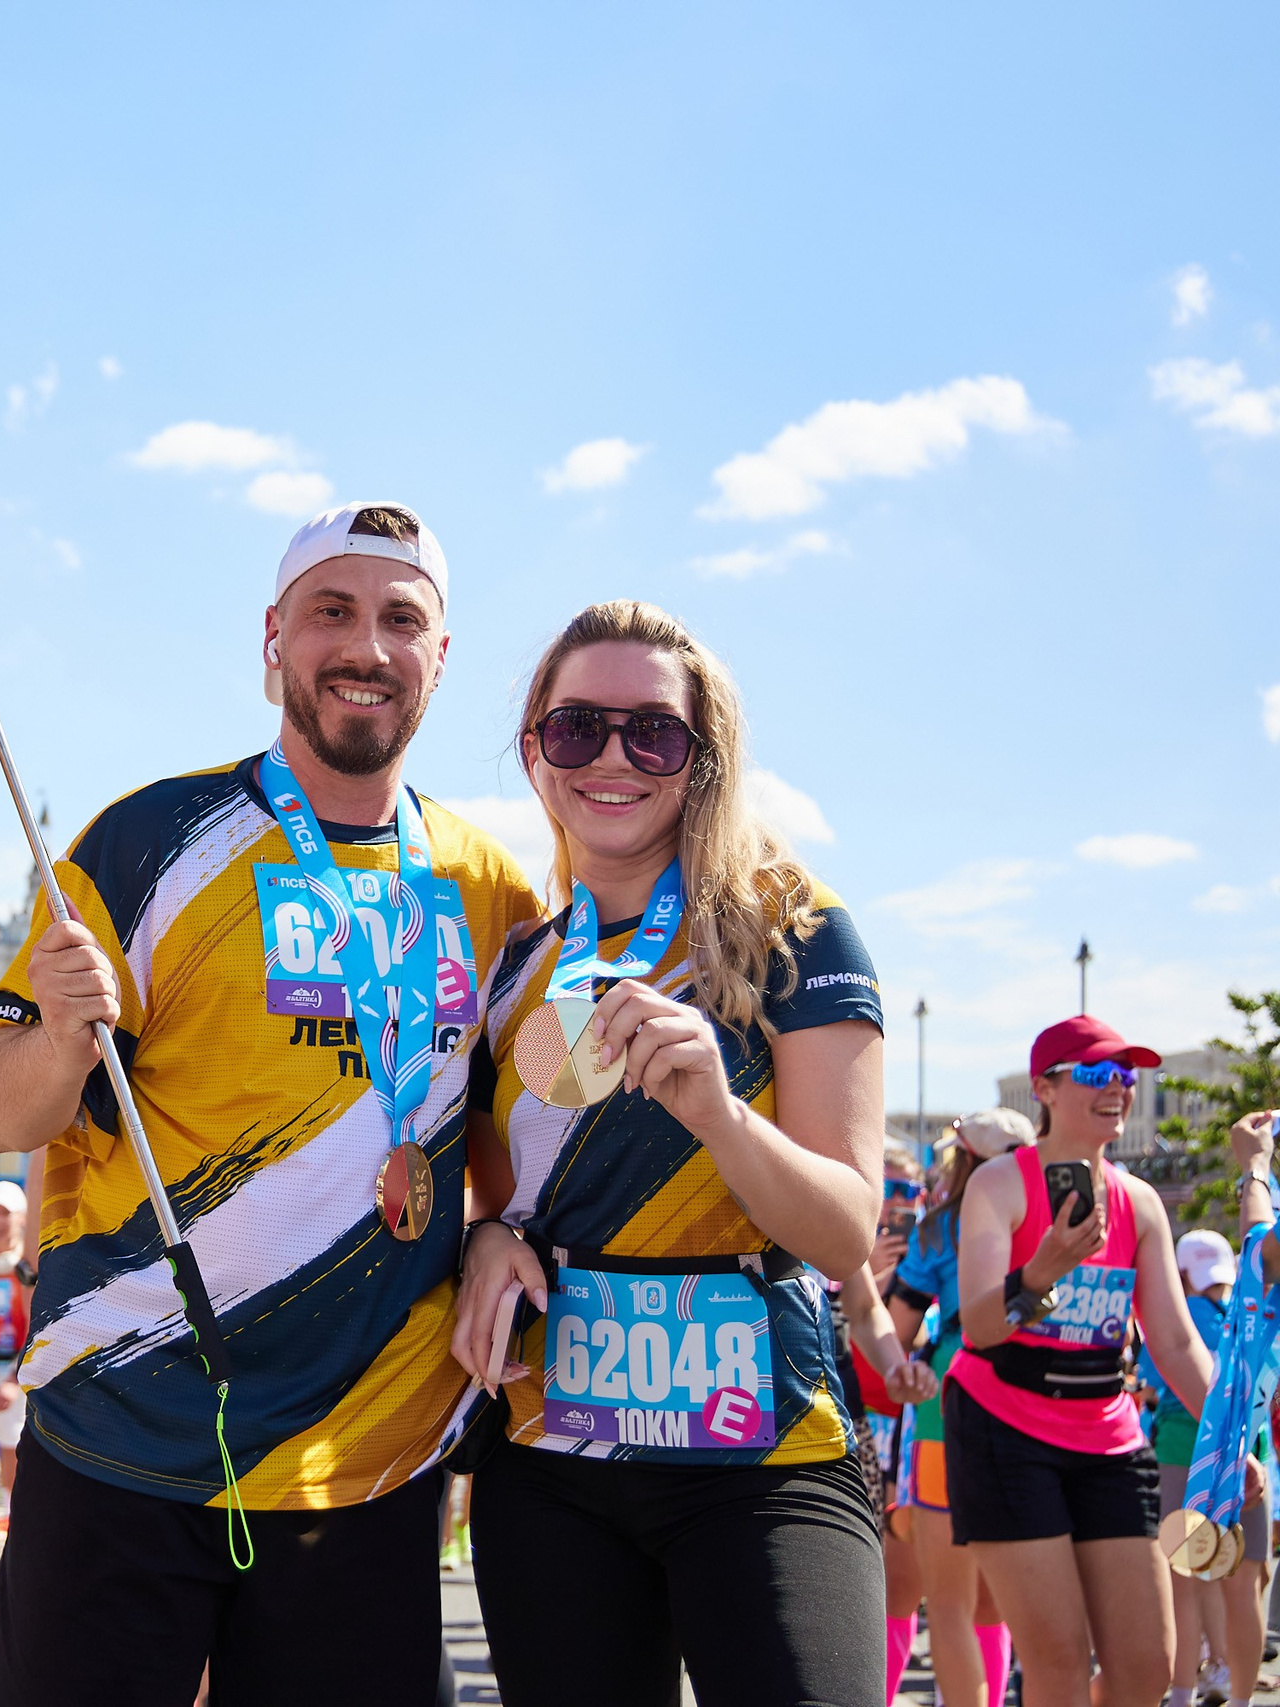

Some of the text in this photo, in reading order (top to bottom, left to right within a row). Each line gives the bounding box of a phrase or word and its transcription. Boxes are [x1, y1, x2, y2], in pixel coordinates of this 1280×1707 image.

[288, 815, 319, 855] ПСБ
[280, 878, 307, 889] ПСБ
[346, 872, 382, 903] 10
[652, 894, 677, 926] ПСБ
[435, 962, 465, 1006] E
[805, 972, 871, 990] ЛЕМАНА
[567, 1285, 589, 1299] ПСБ
[628, 1281, 667, 1315] 10
[1049, 1283, 1126, 1326] 2389
[556, 1314, 758, 1403] 62048
[614, 1407, 689, 1447] 10KM
[709, 1390, 753, 1441] E
